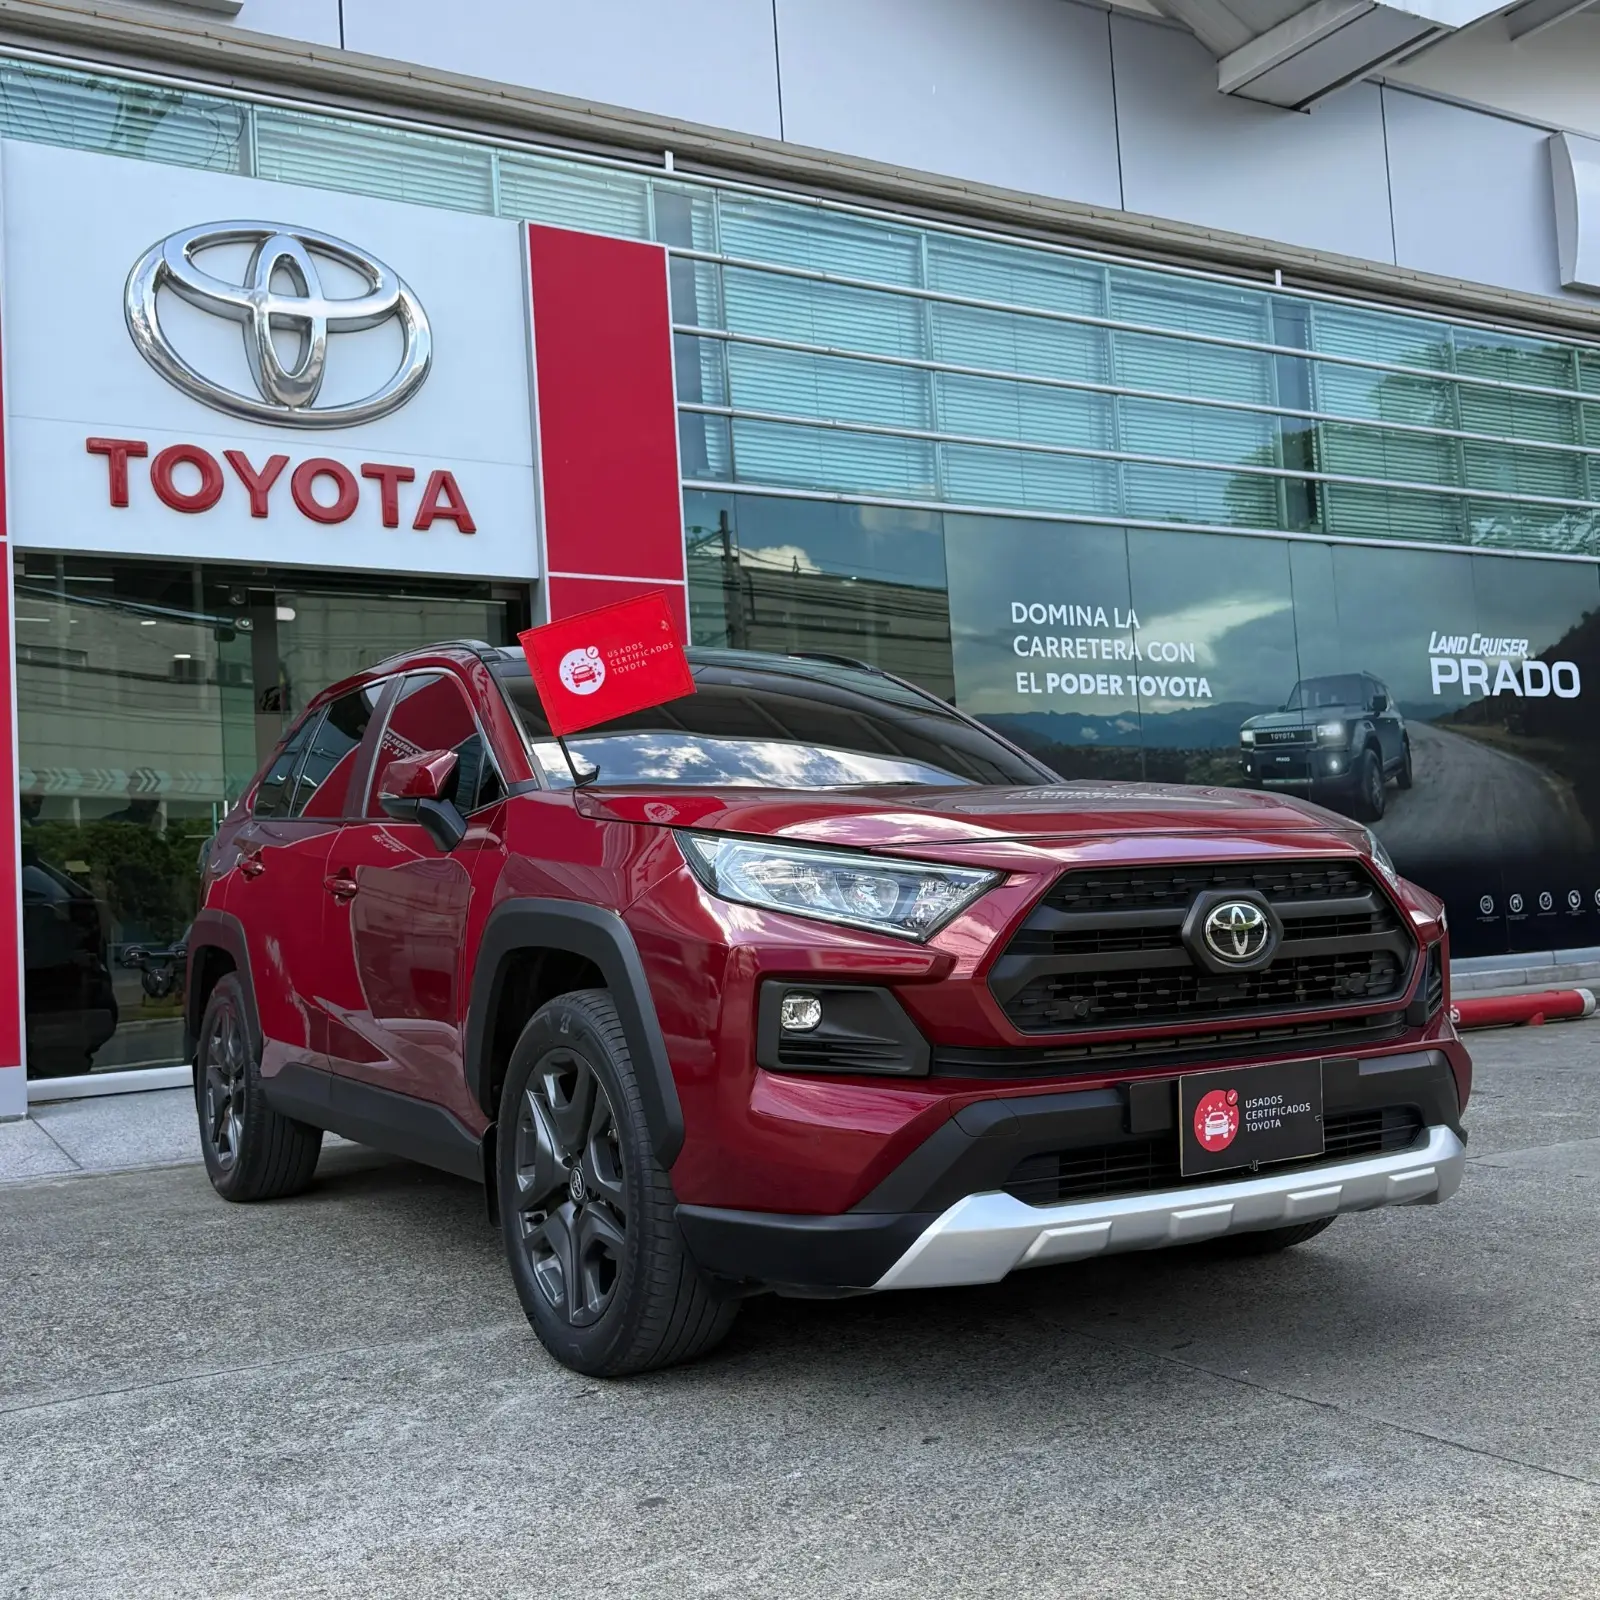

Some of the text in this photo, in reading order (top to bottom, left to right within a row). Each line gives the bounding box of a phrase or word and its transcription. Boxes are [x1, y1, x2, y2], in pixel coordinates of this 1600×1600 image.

[86, 437, 476, 534] TOYOTA
[1011, 602, 1141, 629] DOMINA LA
[607, 641, 644, 658] USADOS
[610, 641, 674, 667] CERTIFICADOS
[1013, 635, 1196, 663] CARRETERA CON
[1428, 630, 1529, 659] LAND CRUISER
[612, 659, 647, 675] TOYOTA
[1429, 657, 1581, 699] PRADO
[1016, 671, 1212, 698] EL PODER TOYOTA
[1270, 732, 1295, 740] TOYOTA
[1245, 1095, 1283, 1109] USADOS
[1245, 1103, 1311, 1121] CERTIFICADOS
[1245, 1119, 1282, 1132] TOYOTA
